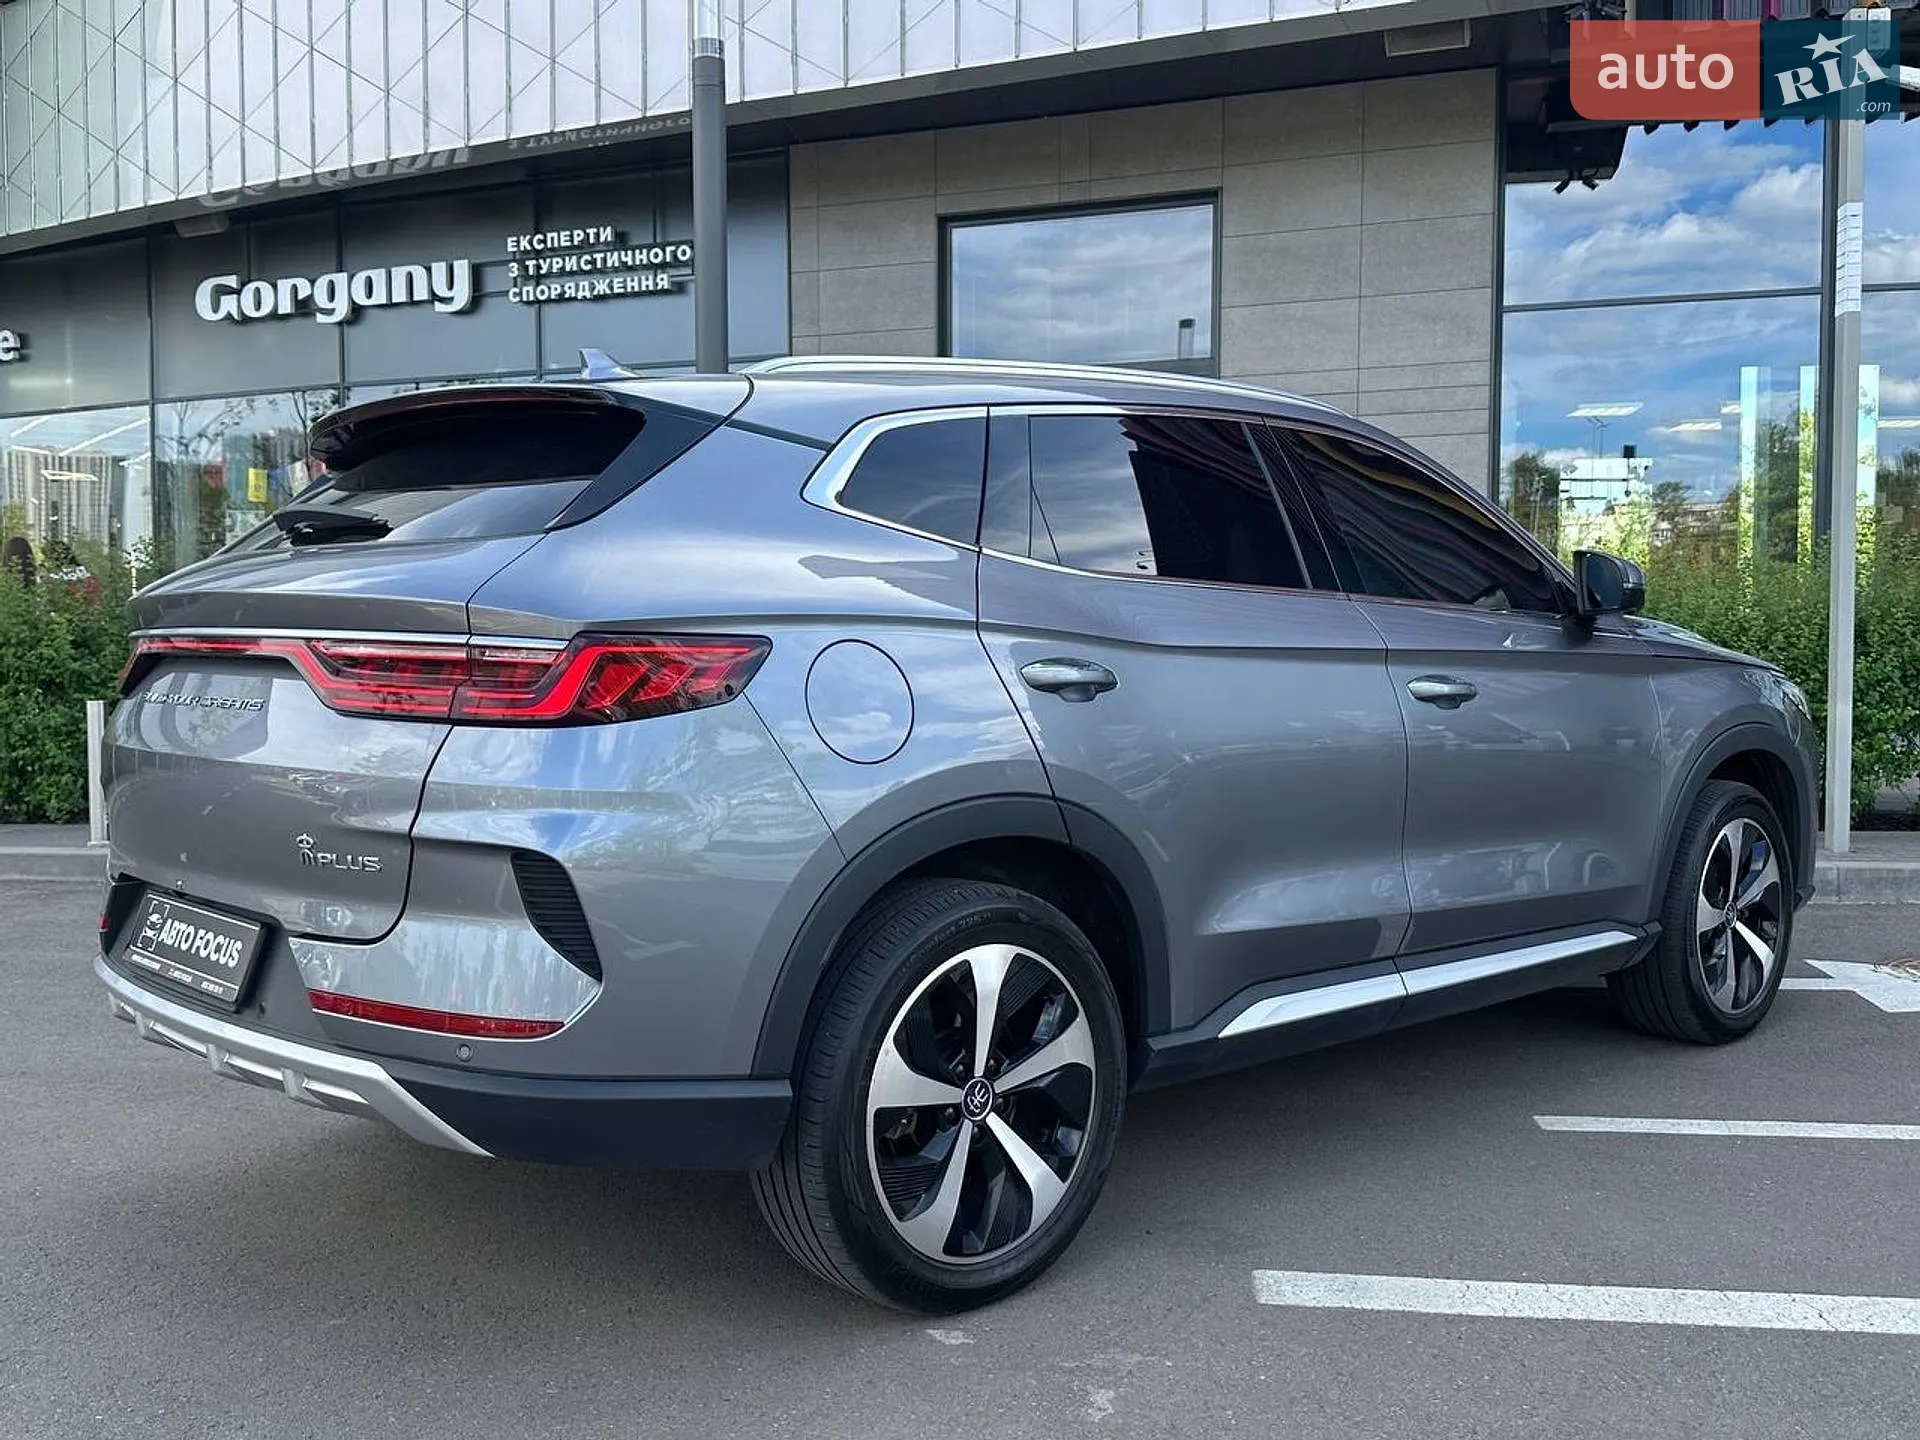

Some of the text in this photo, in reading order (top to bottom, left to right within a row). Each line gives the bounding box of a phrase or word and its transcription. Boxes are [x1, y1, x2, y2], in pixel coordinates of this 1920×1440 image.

[506, 226, 613, 253] ЕКСПЕРТИ
[525, 244, 693, 277] ТУРИСТИЧНОГО
[194, 258, 471, 324] Gorgany
[508, 273, 671, 302] СПОРЯДЖЕННЯ
[317, 852, 383, 872] PLUS
[190, 928, 243, 969] FOCUS
